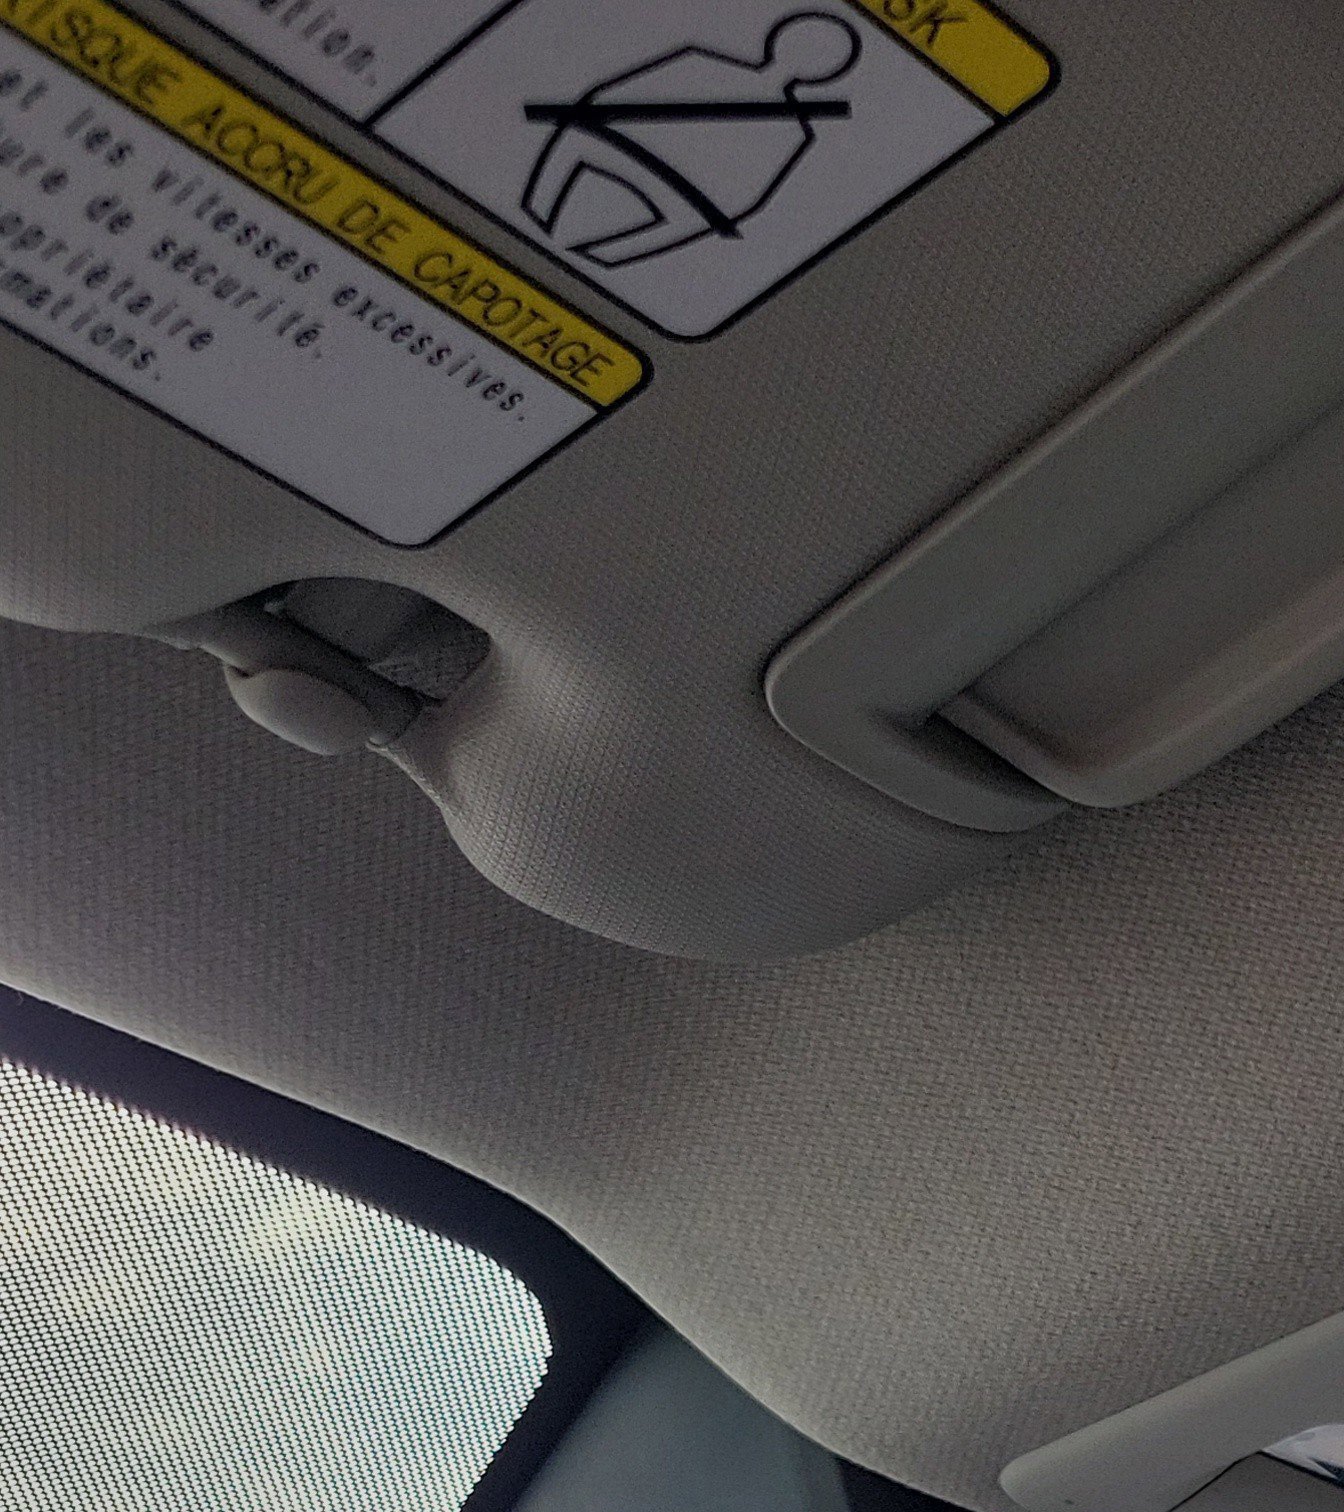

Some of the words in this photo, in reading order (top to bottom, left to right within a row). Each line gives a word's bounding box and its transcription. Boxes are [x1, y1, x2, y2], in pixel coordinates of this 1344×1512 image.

[6, 0, 181, 104] ISQUE
[181, 103, 334, 205] ACCRU
[336, 199, 409, 254] DE
[412, 250, 617, 387] CAPOTAGE
[85, 195, 135, 236] de
[151, 167, 320, 284] vitesses
[332, 284, 527, 422] excessives.
